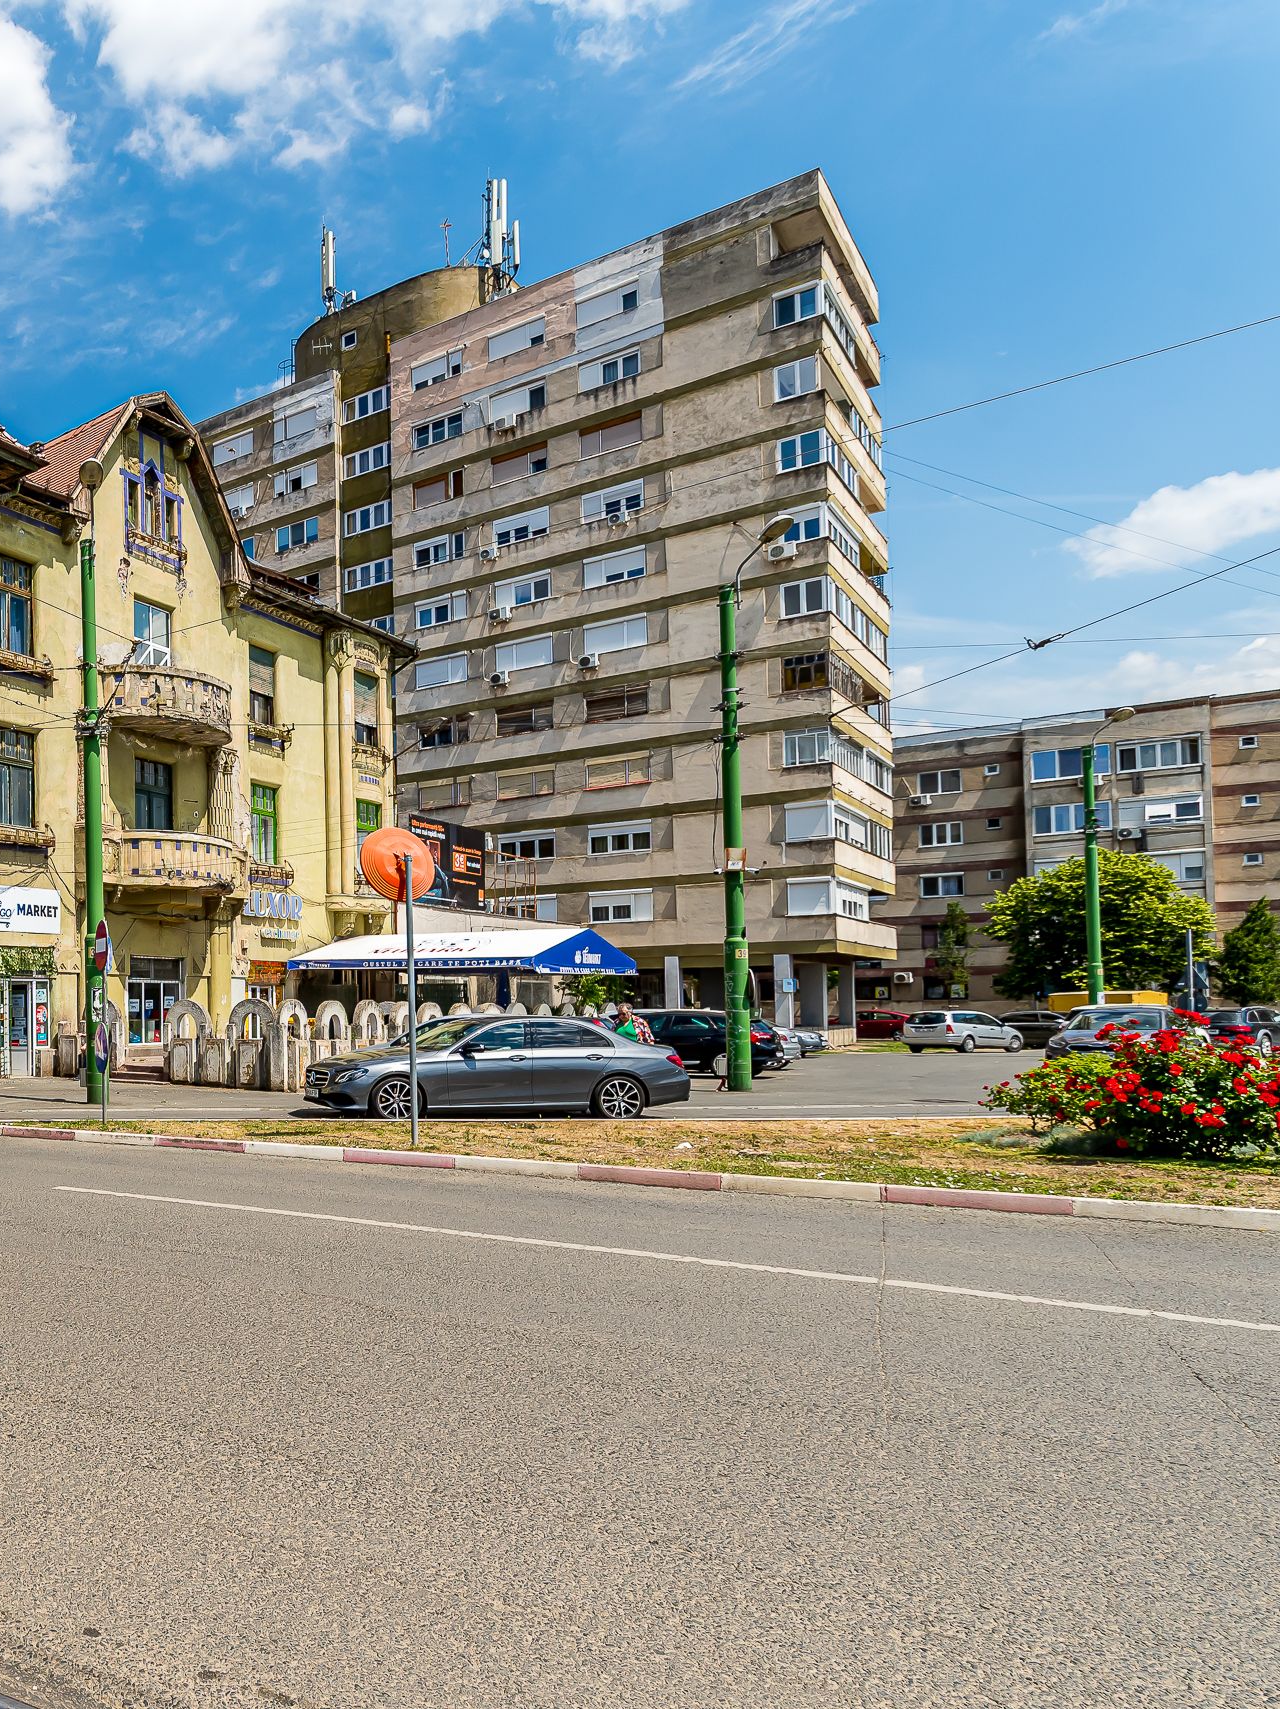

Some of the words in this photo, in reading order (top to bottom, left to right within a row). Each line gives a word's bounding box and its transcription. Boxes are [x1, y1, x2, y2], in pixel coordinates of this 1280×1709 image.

[16, 904, 58, 918] MARKET
[244, 890, 303, 921] LUXOR
[737, 949, 748, 958] 39
